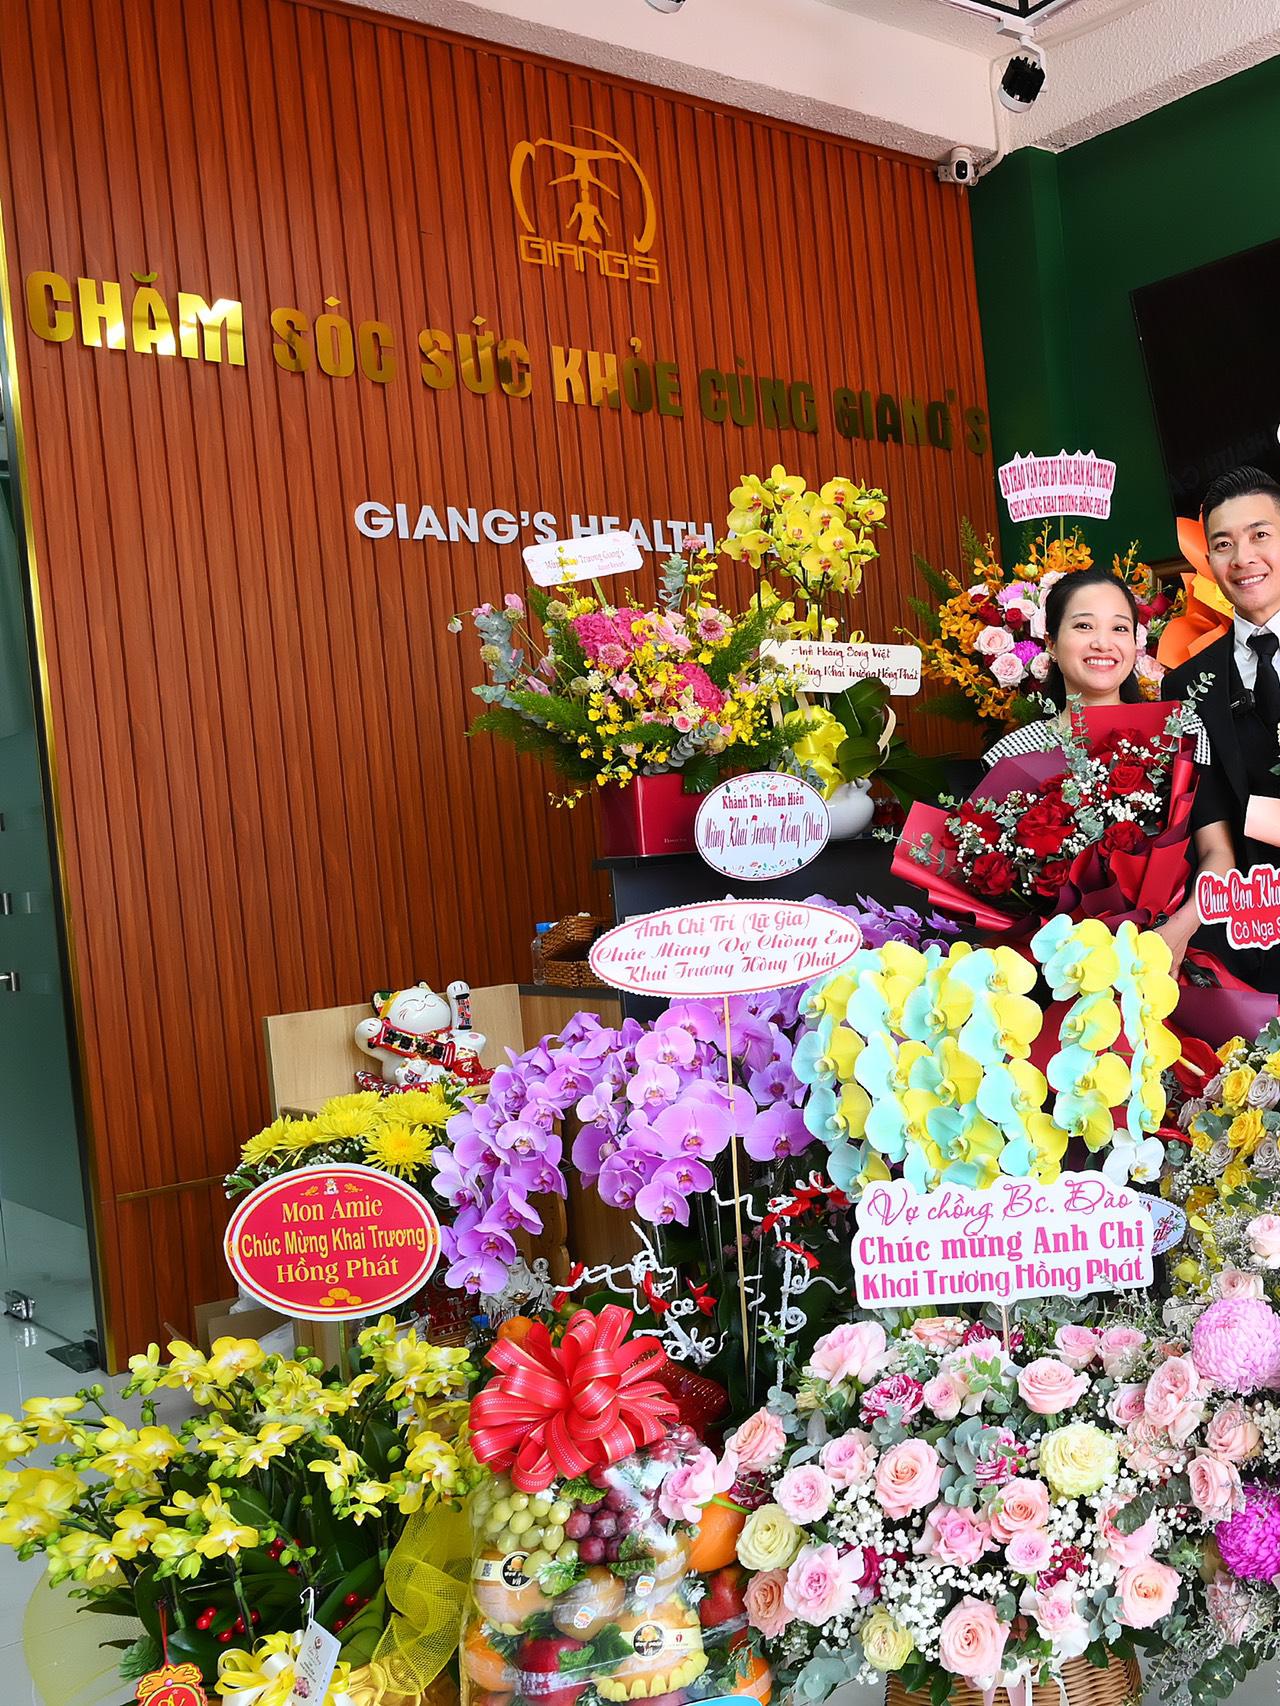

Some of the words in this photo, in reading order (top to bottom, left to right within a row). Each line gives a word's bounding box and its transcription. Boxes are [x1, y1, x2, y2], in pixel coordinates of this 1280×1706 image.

[520, 235, 660, 284] GIANG'S
[26, 271, 246, 367] CHĂM
[354, 500, 557, 546] GIANG'S
[749, 793, 762, 808] Thi
[768, 793, 786, 807] Phan
[1231, 879, 1255, 912] Con
[634, 915, 672, 940] Anh
[677, 916, 706, 938] Chị
[710, 912, 735, 932] Trí
[774, 909, 811, 929] Gia)
[1233, 920, 1250, 940] Cô
[1251, 919, 1274, 941] Nga
[597, 943, 646, 963] Chúc
[651, 940, 711, 959] Mừng
[718, 938, 752, 955] Vợ
[757, 931, 818, 950] Chồng
[824, 931, 855, 944] Em
[625, 964, 668, 984] Khai
[675, 961, 735, 980] Trương
[742, 953, 788, 975] Hồng
[794, 951, 839, 970] Phát
[281, 1202, 325, 1224] Mon
[330, 1195, 384, 1220] Amie
[867, 1187, 919, 1227] Vợ
[928, 1191, 993, 1237] chồng
[1064, 1179, 1133, 1216] Đào
[241, 1231, 281, 1258] Chúc
[284, 1226, 329, 1258] Mừng
[332, 1225, 366, 1252] Khai
[367, 1223, 427, 1252] Trương
[859, 1235, 930, 1266] Chúc
[941, 1231, 1022, 1262] mừng
[1033, 1224, 1089, 1254] Anh
[1099, 1219, 1145, 1252] Chị
[276, 1256, 340, 1284] Hồng
[346, 1254, 400, 1278] Phát
[862, 1270, 919, 1300] Khai
[923, 1266, 1011, 1298] Trương
[1015, 1258, 1082, 1292] Hồng
[1086, 1253, 1145, 1285] Phát
